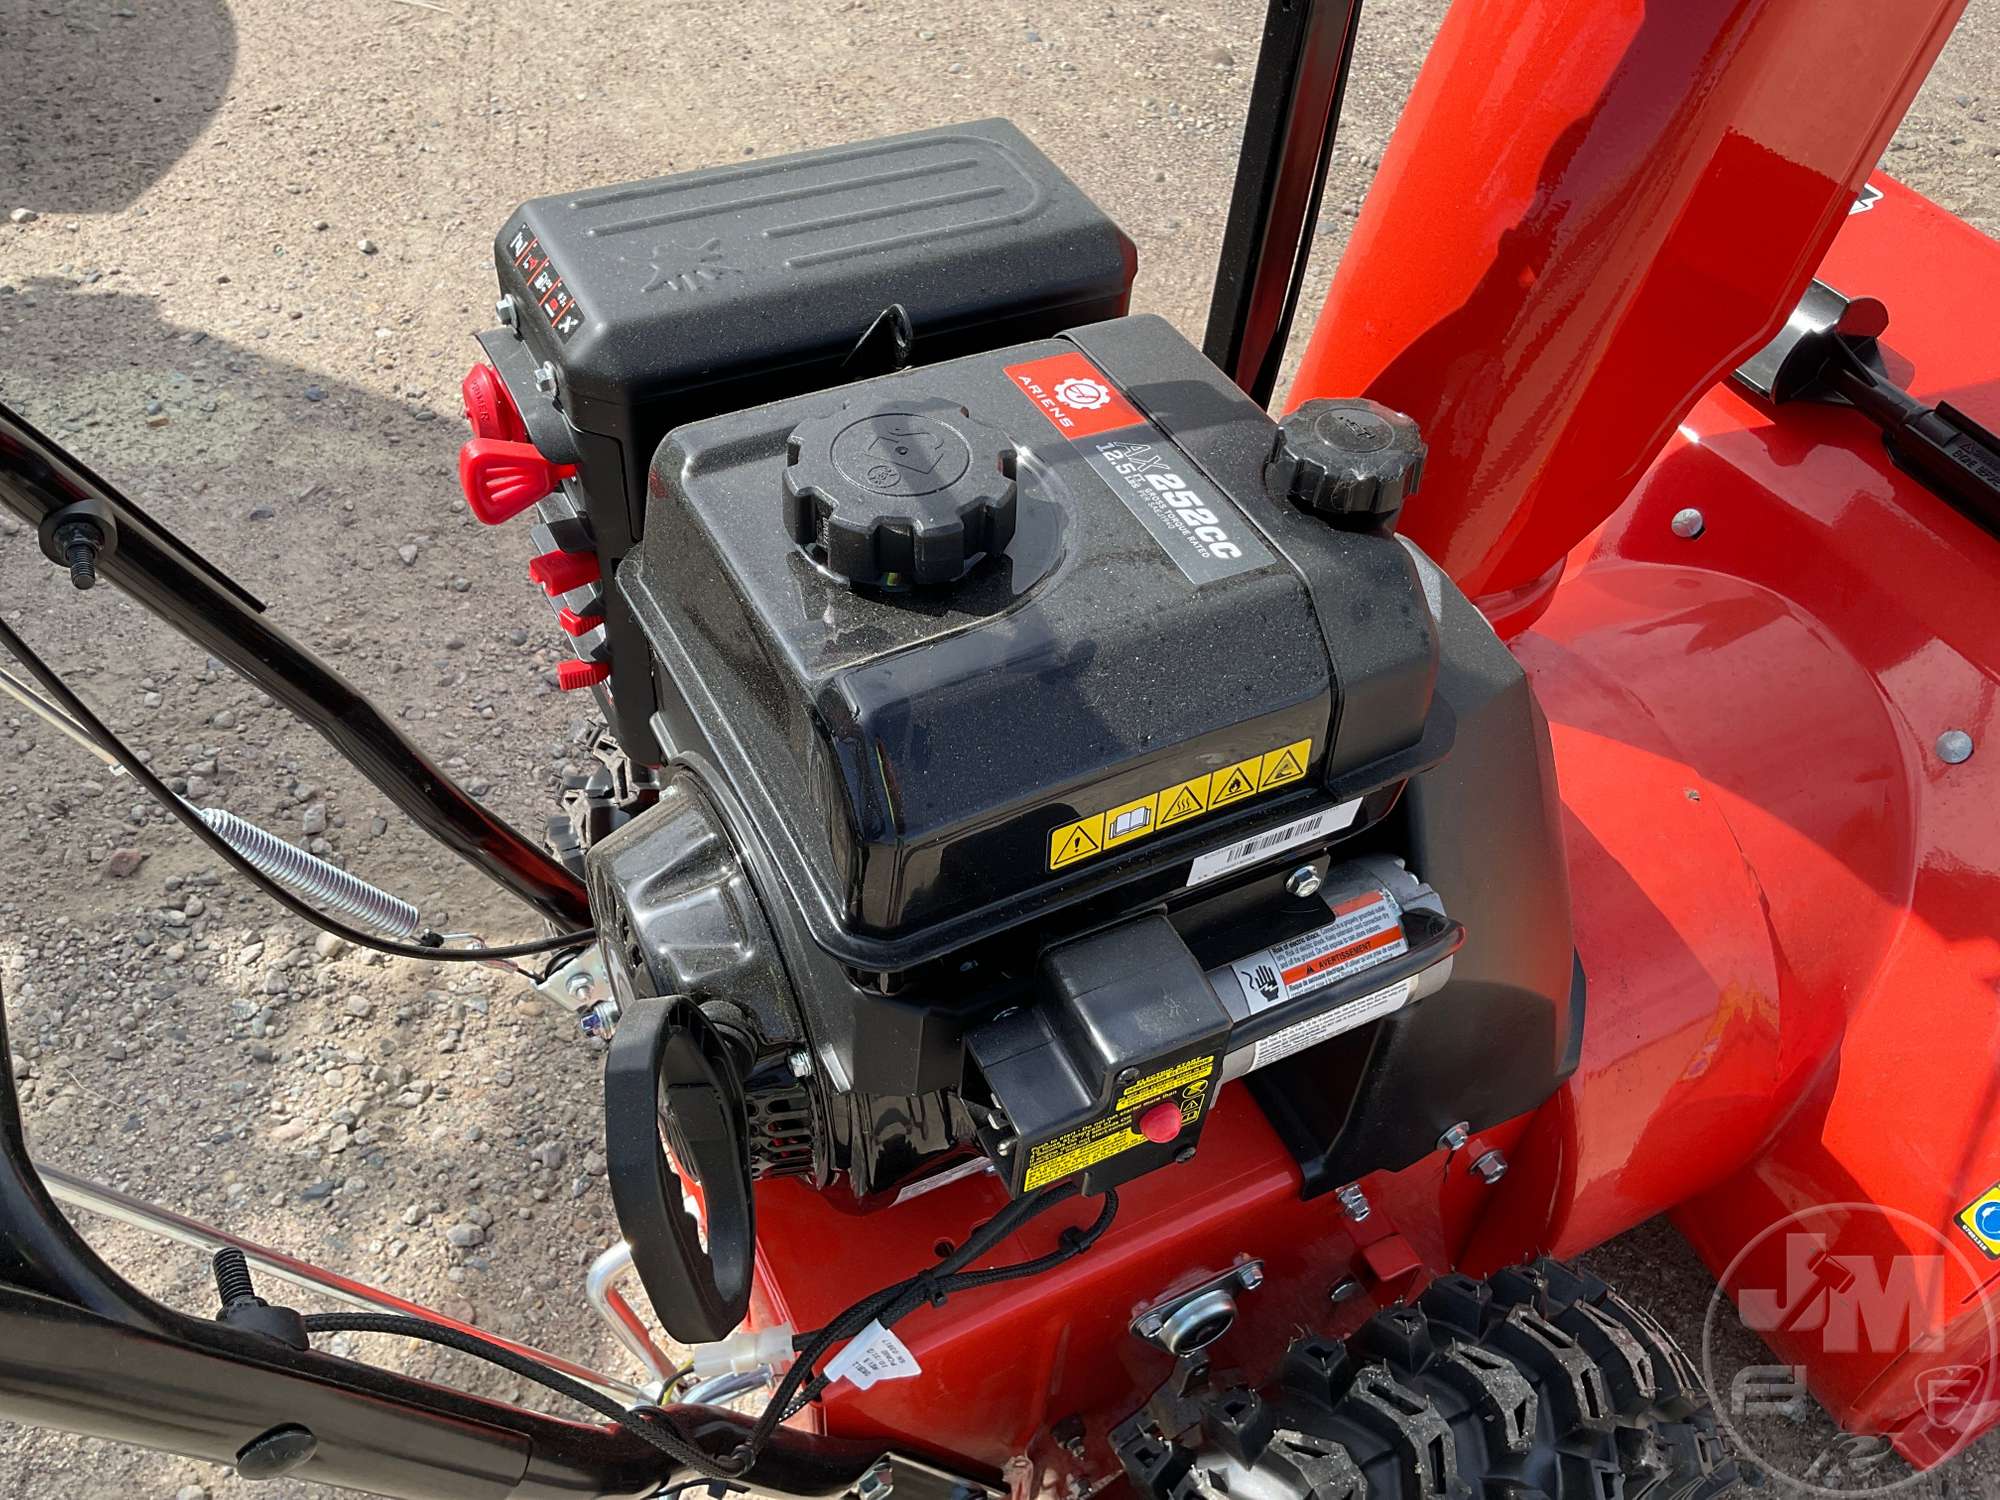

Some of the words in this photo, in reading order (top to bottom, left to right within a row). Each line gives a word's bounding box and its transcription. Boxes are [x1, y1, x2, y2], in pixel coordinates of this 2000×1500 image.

[1018, 374, 1075, 428] ARIENS
[1095, 442, 1137, 474] 12.5
[1145, 487, 1167, 510] GROSS
[1165, 510, 1192, 536] TORQUE
[1187, 535, 1210, 558] RATED
[1318, 940, 1371, 968] AVERTISSEMENT
[1176, 1055, 1202, 1070] START
